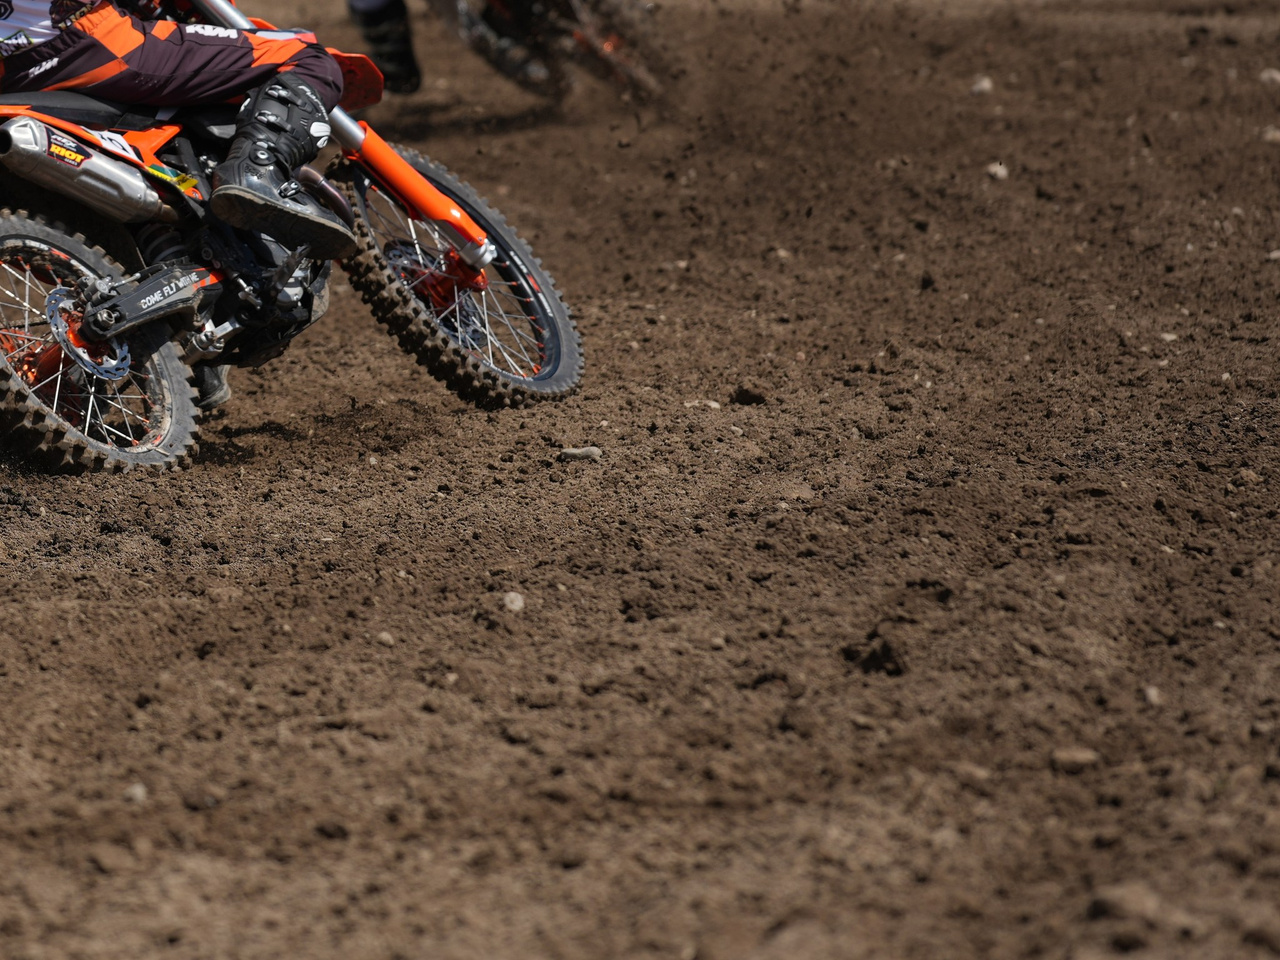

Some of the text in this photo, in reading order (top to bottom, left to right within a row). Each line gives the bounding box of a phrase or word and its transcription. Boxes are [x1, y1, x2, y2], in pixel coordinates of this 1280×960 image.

[186, 23, 239, 39] KTM
[49, 143, 85, 163] RIOT
[140, 290, 164, 309] COME
[162, 282, 177, 297] FLY
